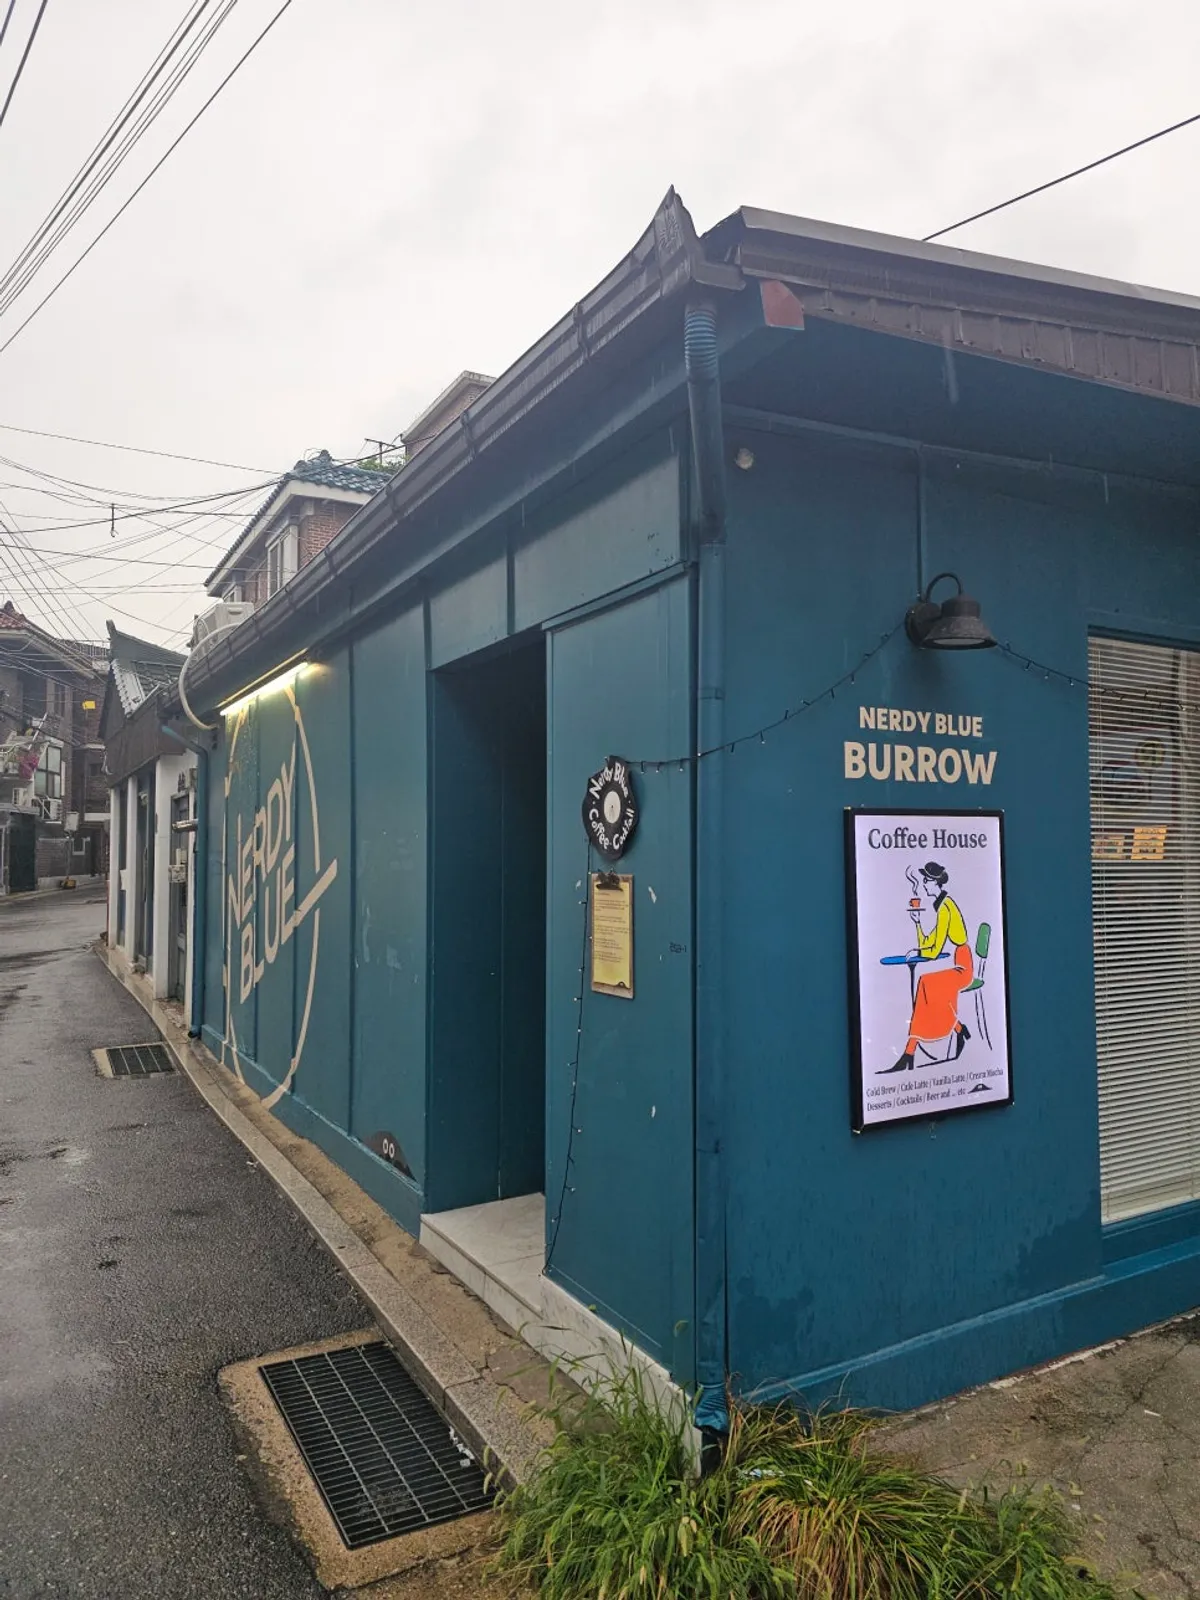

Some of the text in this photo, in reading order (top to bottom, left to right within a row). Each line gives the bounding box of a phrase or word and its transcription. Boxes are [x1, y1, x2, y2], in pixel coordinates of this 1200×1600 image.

[859, 706, 983, 738] NERDY BLUE
[844, 741, 998, 785] BURROW
[227, 739, 297, 950] NERDY
[868, 827, 988, 849] Coffee House
[239, 843, 312, 1005] BLUE
[866, 1086, 880, 1097] Cold
[881, 1085, 896, 1095] Brew
[914, 1080, 928, 1090] Latte
[933, 1076, 951, 1086] Vanilla
[952, 1074, 965, 1083] Latte
[867, 1100, 892, 1111] Desserts
[896, 1094, 922, 1106] Cocktails
[926, 1091, 940, 1101] Beer
[940, 1089, 950, 1098] and
